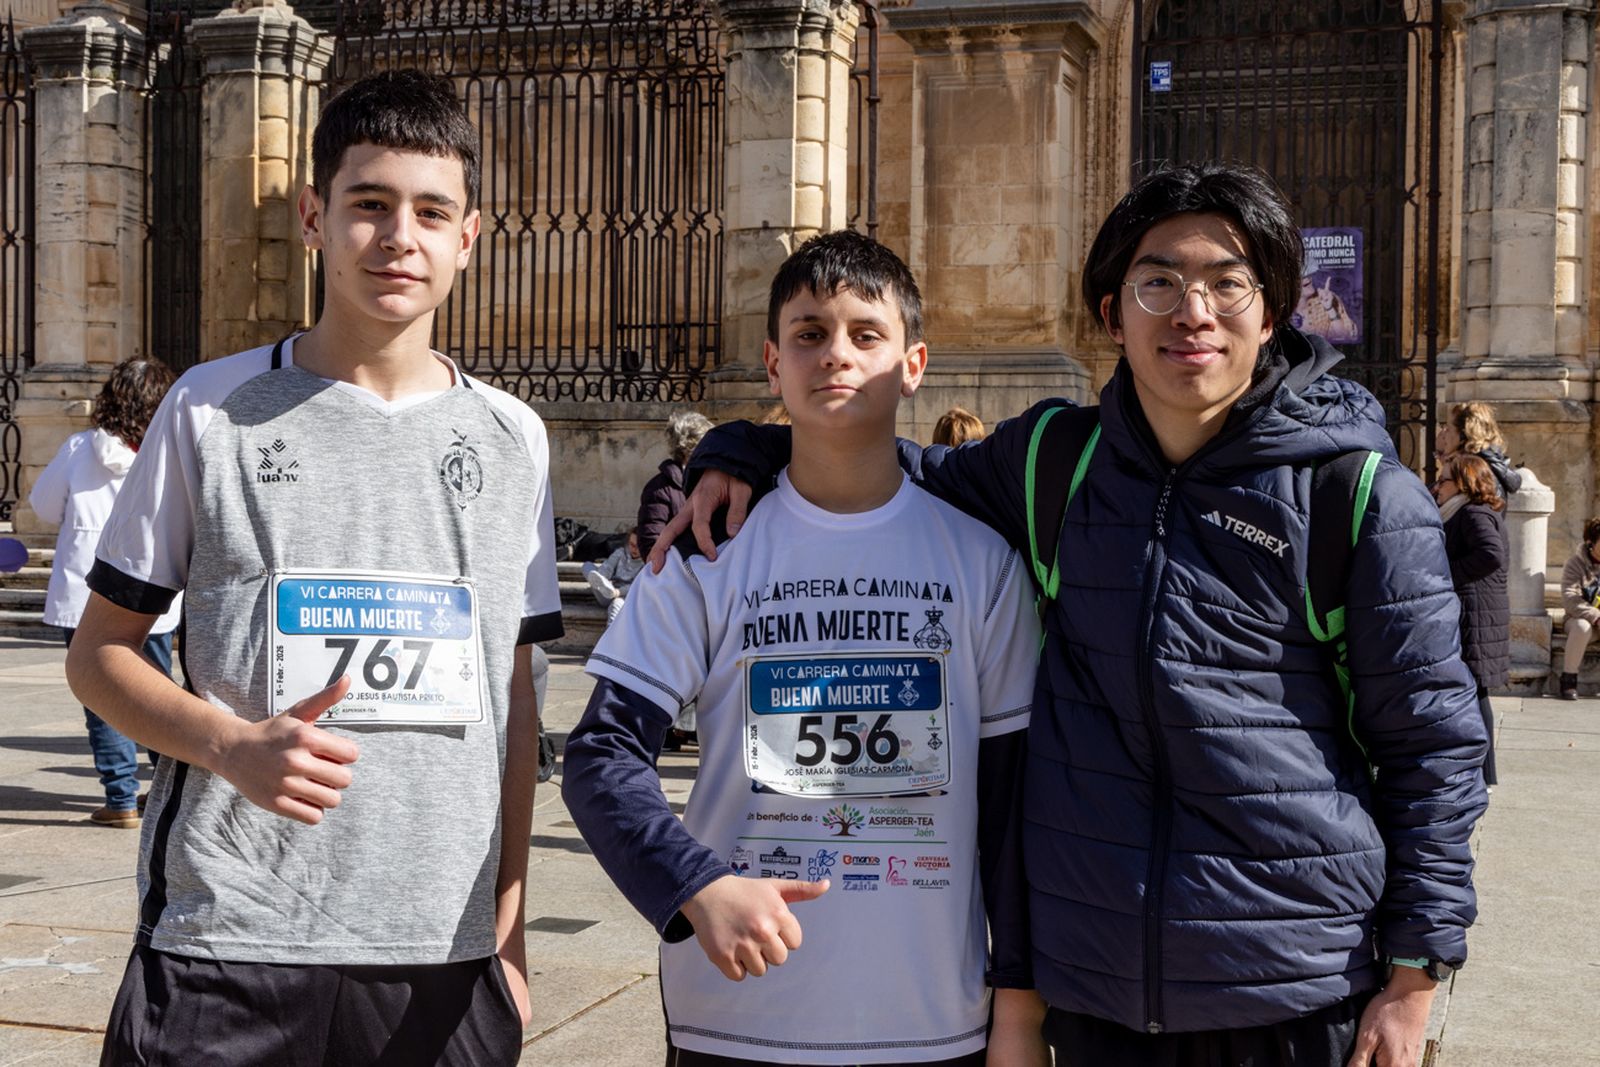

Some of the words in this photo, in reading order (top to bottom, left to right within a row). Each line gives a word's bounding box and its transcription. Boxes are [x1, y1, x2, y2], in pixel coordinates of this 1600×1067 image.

[1304, 236, 1355, 248] CATEDRAL
[1328, 248, 1355, 258] NUNCA
[1225, 515, 1290, 558] TERREX
[301, 586, 314, 600] VI
[318, 586, 382, 600] CARRERA
[386, 588, 451, 605] CAMINATA
[744, 590, 760, 609] VI
[854, 577, 954, 603] CAMINATA
[301, 607, 355, 629] BUENA
[360, 608, 423, 631] MUERTE
[742, 612, 808, 651] BUENA
[817, 610, 910, 642] MUERTE
[325, 638, 434, 690] 767
[771, 668, 784, 680] VI
[787, 664, 848, 679] CARRERA
[852, 664, 920, 677] CAMINATA
[382, 692, 418, 701] BAUTISTA
[771, 686, 822, 708] BUENA
[828, 684, 890, 706] MUERTE
[796, 714, 900, 766] 556
[784, 768, 803, 776] JOSÉ
[806, 766, 832, 776] MARÍA
[869, 806, 908, 815] Asociación
[756, 812, 798, 822] beneficio
[801, 813, 812, 822] de
[869, 816, 934, 826] ASPERGER-TEA
[914, 827, 934, 837] Jaén
[761, 870, 798, 879] BYD
[808, 866, 832, 876] CUA
